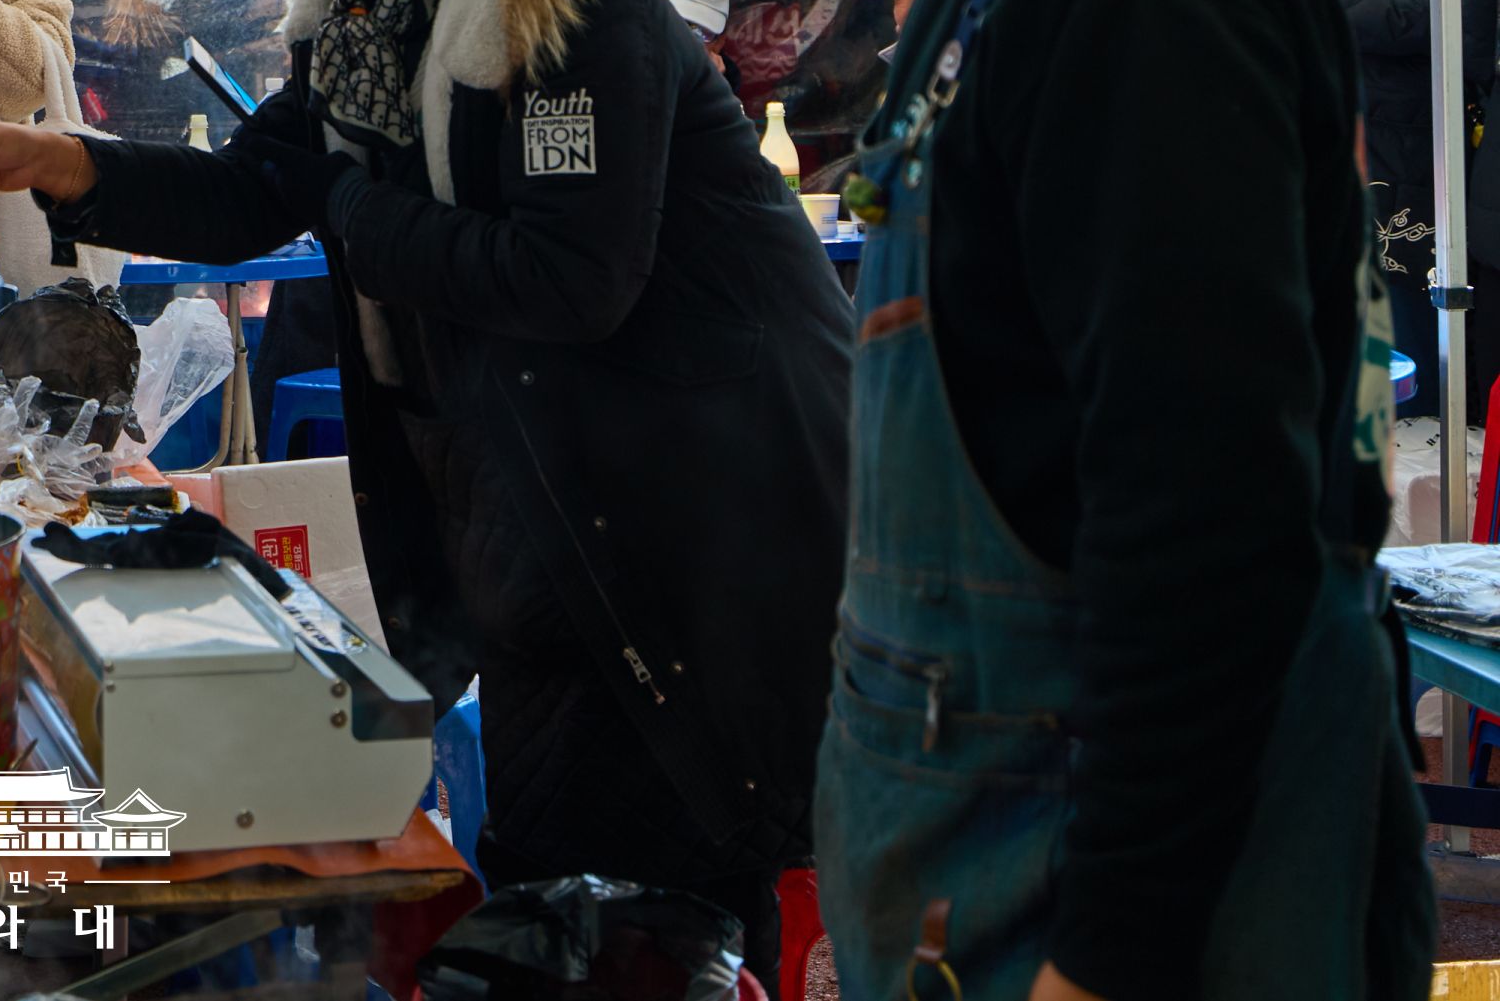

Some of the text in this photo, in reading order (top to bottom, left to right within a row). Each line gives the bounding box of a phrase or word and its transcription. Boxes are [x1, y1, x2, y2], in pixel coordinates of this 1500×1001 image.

[524, 88, 593, 117] Youth
[541, 117, 590, 127] INSPIRATION
[528, 127, 590, 146] FROM
[529, 144, 591, 173] LDN
